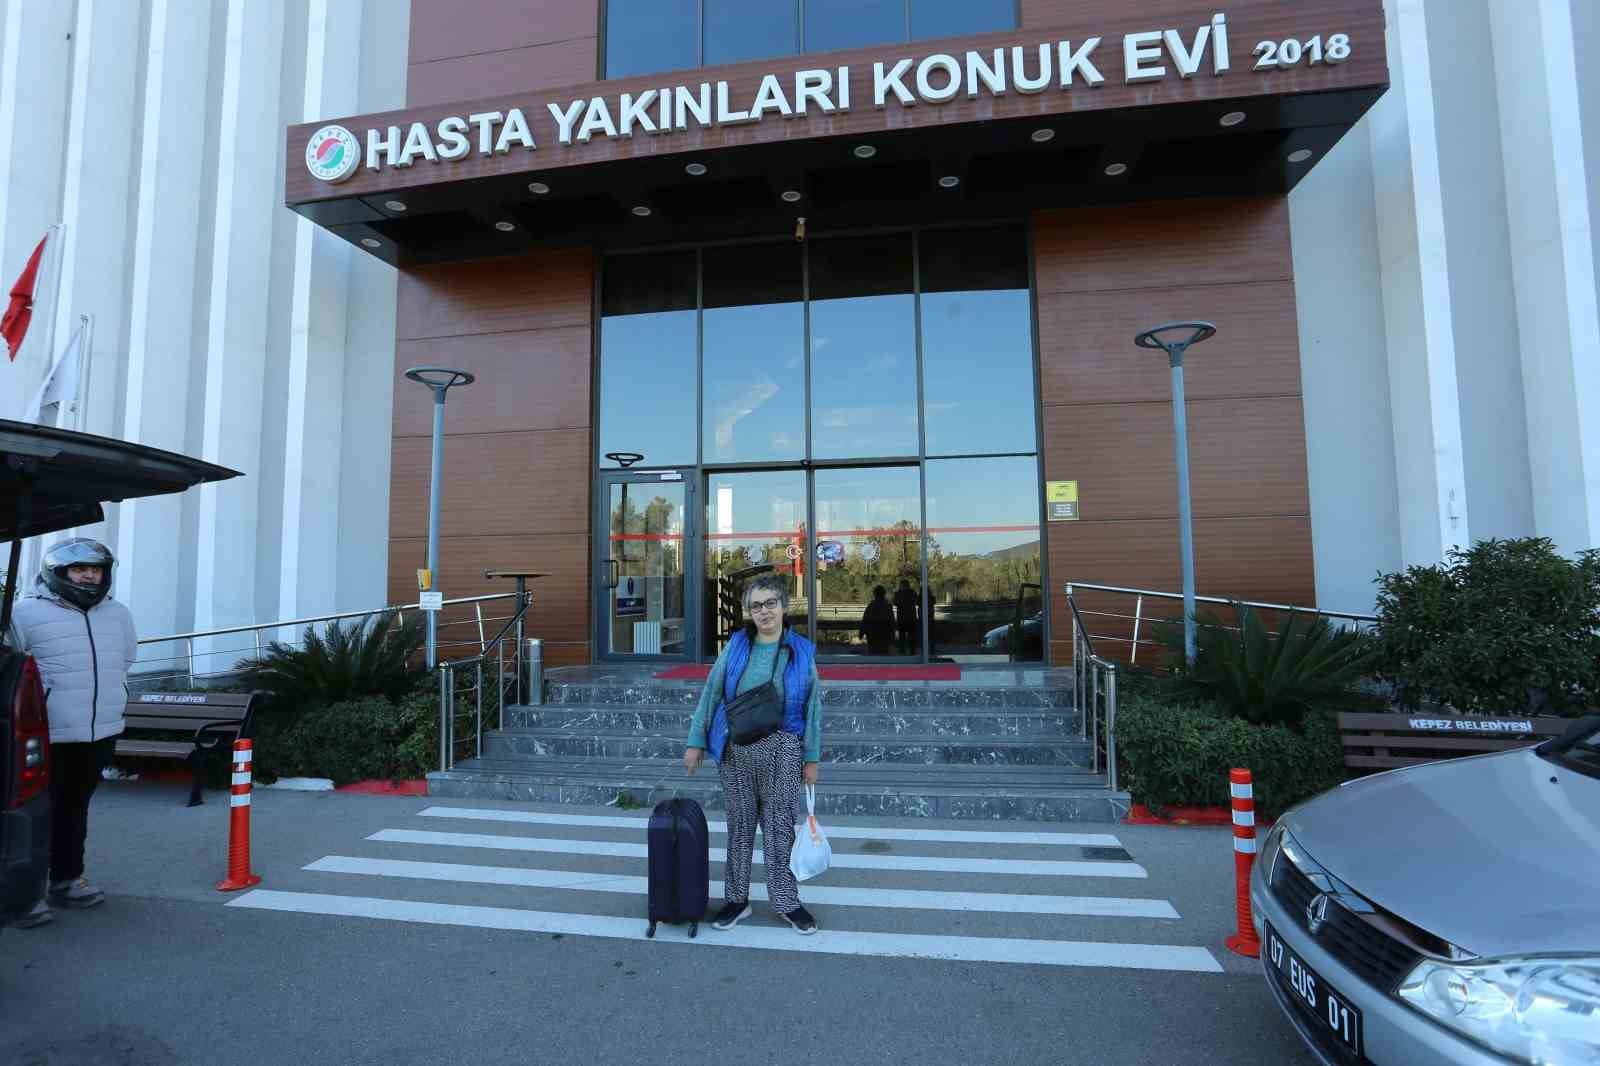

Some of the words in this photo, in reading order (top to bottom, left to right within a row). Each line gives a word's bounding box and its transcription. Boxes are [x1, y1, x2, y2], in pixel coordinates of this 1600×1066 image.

[1252, 33, 1351, 70] 2018
[366, 108, 536, 171] HASTA
[547, 66, 850, 146] YAKINLARI
[874, 37, 1105, 107] KONUK
[1124, 13, 1230, 85] EVİ
[1409, 719, 1453, 729] KEPEZ
[1455, 720, 1533, 732] BELEDİYESİ
[1270, 935, 1284, 968] 07
[1290, 958, 1316, 1008] EUS
[1328, 996, 1349, 1042] 01
